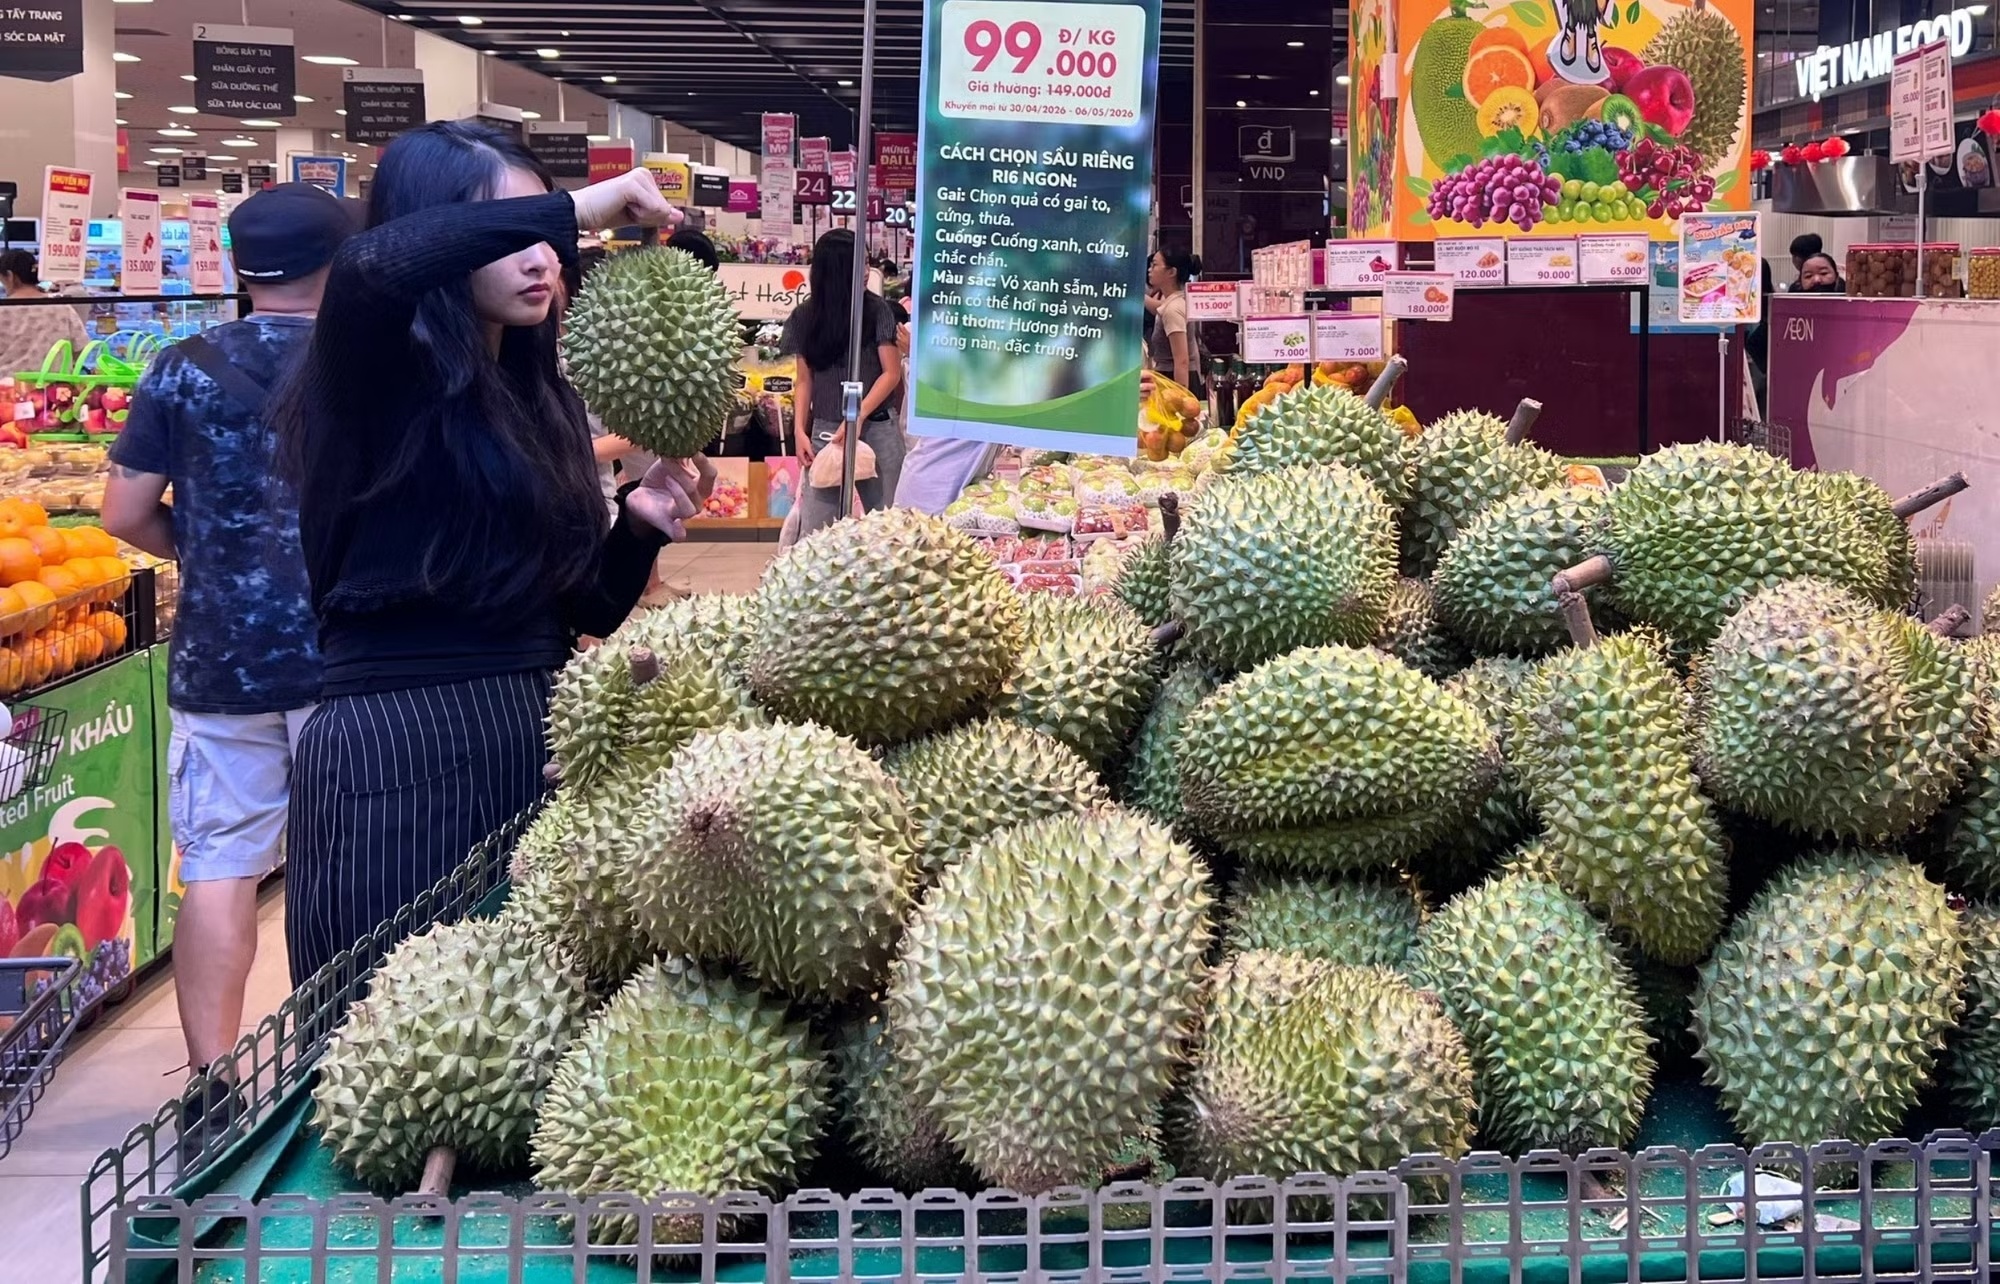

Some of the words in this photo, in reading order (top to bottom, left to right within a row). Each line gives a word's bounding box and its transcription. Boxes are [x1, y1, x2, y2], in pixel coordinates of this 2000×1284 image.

[28, 10, 62, 20] TRANG
[4, 30, 25, 41] SÓC
[27, 33, 42, 42] DA
[44, 32, 66, 44] MẶT
[197, 26, 207, 39] 2
[1089, 30, 1116, 45] KG
[258, 49, 272, 57] TAI
[1796, 45, 1841, 103] VIỆT
[1843, 31, 1893, 85] NAM
[1897, 9, 1972, 57] FOOD
[346, 69, 354, 80] 3
[968, 80, 989, 93] Giá
[993, 81, 1041, 98] thường:
[1047, 84, 1111, 98] 149.000đ
[245, 101, 261, 109] CÁC
[945, 101, 977, 112] Khuyến
[979, 102, 997, 113] mại
[999, 103, 1007, 112] từ
[1010, 104, 1066, 117] 30/04/2026
[1075, 106, 1134, 119] 06/05/2026
[940, 142, 984, 162] CÁCH
[990, 148, 1037, 167] CHỌN
[1043, 146, 1078, 166] SẦU
[1082, 150, 1134, 170] RIÊNG
[993, 169, 1019, 184] RI6
[1023, 171, 1077, 188] NGON:
[1250, 167, 1285, 181] VND
[798, 177, 826, 196] 24
[832, 190, 856, 208] 22
[867, 199, 879, 215] 1
[937, 187, 966, 201] Gai:
[970, 188, 1007, 207] Chọn
[1011, 192, 1038, 209] quả
[1043, 193, 1060, 208] có
[1064, 196, 1087, 212] gai
[1092, 197, 1111, 214] to,
[885, 207, 906, 223] 20
[936, 208, 975, 225] cứng,
[979, 211, 1015, 227] thưa.
[936, 229, 987, 246] Cuống:
[991, 231, 1038, 251] Cuống
[1041, 237, 1082, 254] xanh,
[1086, 239, 1129, 257] cứng,
[934, 250, 966, 265] chắc
[970, 253, 1008, 267] chắn.
[933, 269, 963, 284] Màu
[967, 271, 996, 287] sắc:
[1001, 274, 1019, 290] Vỏ
[1023, 279, 1059, 293] xanh
[1063, 278, 1098, 298] sẫm,
[1102, 283, 1127, 298] khi
[1358, 274, 1384, 282] 69.00
[932, 291, 961, 306] chín
[965, 292, 982, 307] có
[986, 294, 1009, 309] thể
[1013, 298, 1035, 312] hơi
[1040, 299, 1068, 316] ngả
[1072, 302, 1113, 321] vàng.
[932, 311, 958, 325] Mùi
[962, 313, 1005, 330] thơm:
[1009, 317, 1059, 336] Hương
[1062, 322, 1102, 339] thơm
[971, 333, 1000, 351] nàn,
[1004, 339, 1030, 355] đặc
[1034, 342, 1079, 360] trưng.
[70, 699, 133, 756] KHẨU
[34, 774, 75, 812] Fruit
